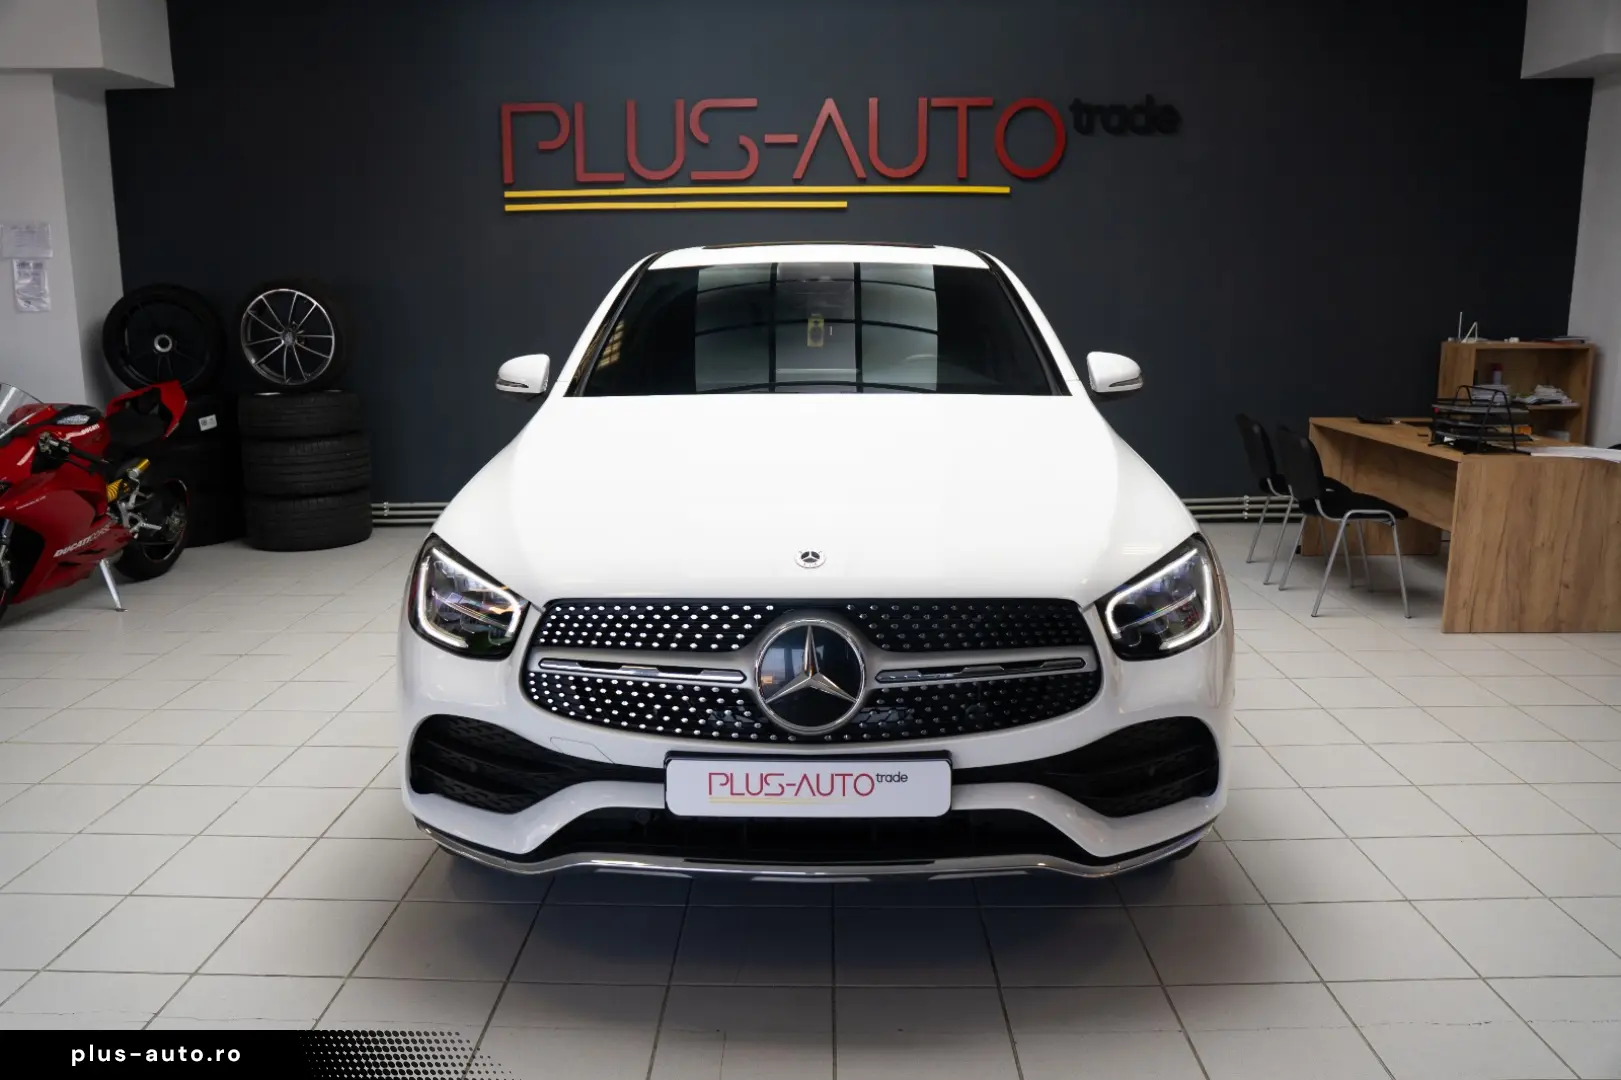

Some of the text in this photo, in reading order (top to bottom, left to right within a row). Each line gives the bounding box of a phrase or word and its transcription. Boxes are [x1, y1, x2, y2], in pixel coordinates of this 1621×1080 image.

[502, 94, 1183, 184] PLUS-AUTO trade
[708, 772, 908, 797] PLUS-AUTO trade
